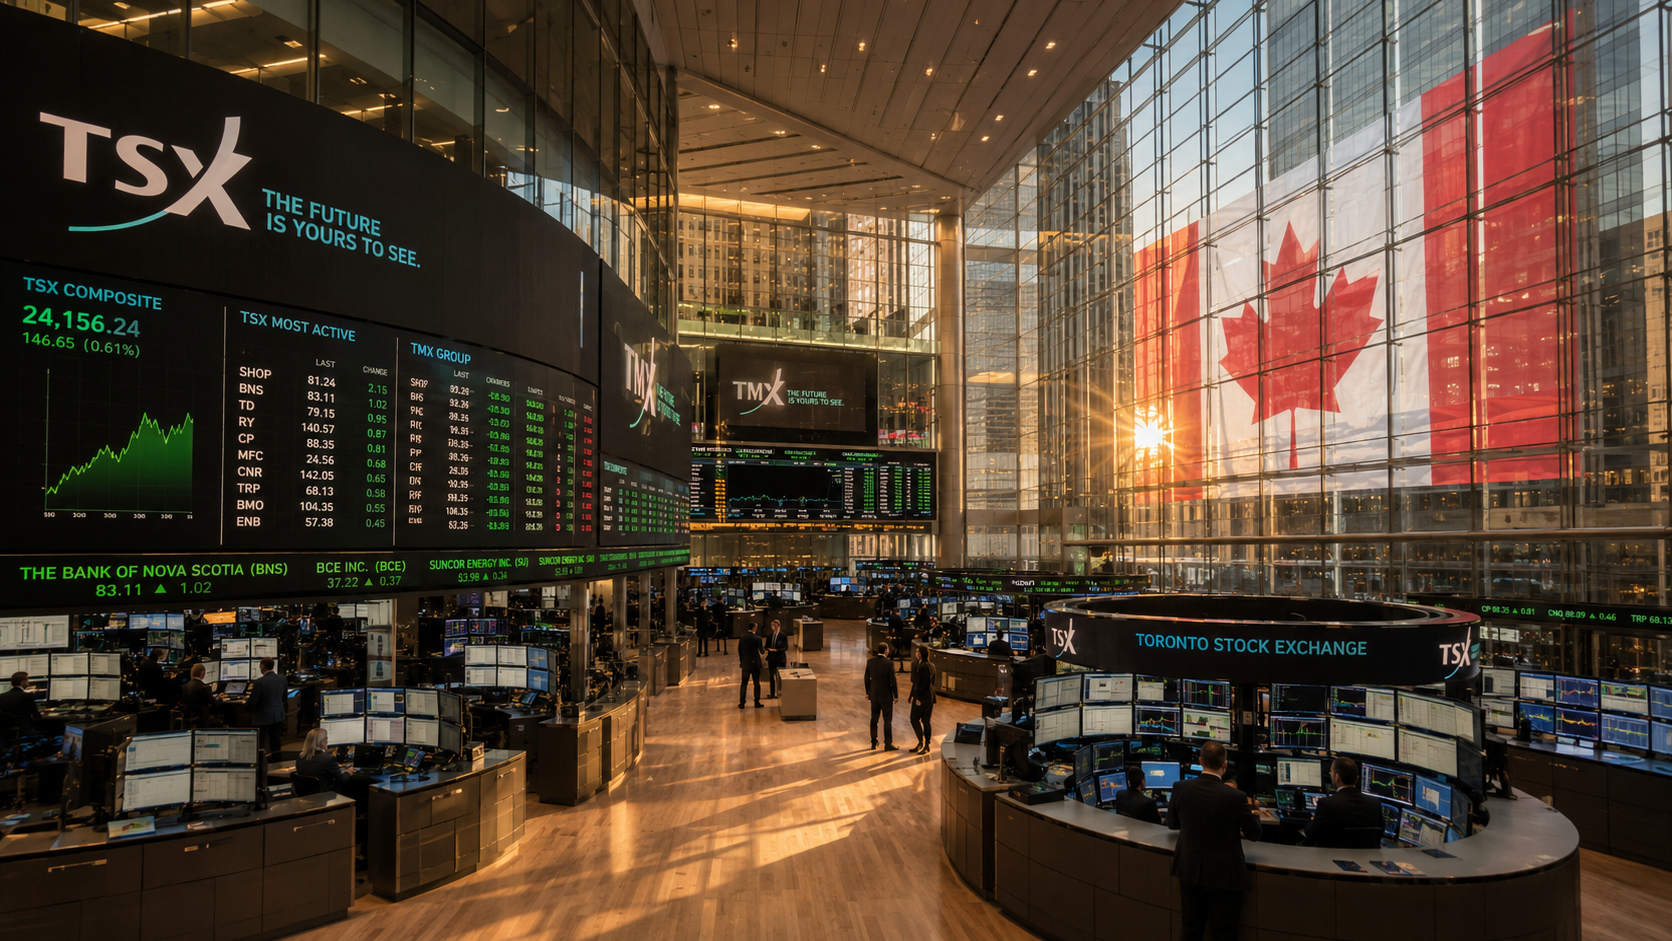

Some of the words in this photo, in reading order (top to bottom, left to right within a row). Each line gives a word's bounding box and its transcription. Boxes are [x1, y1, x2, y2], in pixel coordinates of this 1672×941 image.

[40, 112, 252, 231] TSX
[262, 188, 303, 216] THE
[309, 201, 381, 236] FUTURE
[267, 213, 286, 233] IS
[293, 218, 358, 250] YOURS
[362, 237, 383, 257] TO
[389, 245, 420, 268] SEE.
[23, 277, 58, 294] TSX
[64, 284, 162, 310] COMPOSITE
[23, 305, 141, 338] 24,156.24
[240, 311, 267, 326] TSX
[272, 316, 309, 333] MOST
[312, 324, 355, 341] ACTIVE
[23, 332, 74, 348] 146.65
[84, 339, 139, 358] (0.61%)
[411, 343, 433, 357] TMX
[437, 348, 471, 364] GROUP
[316, 359, 335, 367] LAST
[363, 366, 387, 376] CHANGE
[454, 370, 469, 378] LAST
[623, 336, 657, 418] TMX
[240, 367, 271, 379] SHOP
[308, 376, 335, 387] 81.24
[369, 383, 387, 394] 2.15
[732, 368, 786, 407] TMX
[240, 383, 263, 395] BNS
[308, 391, 334, 403] 83.11
[369, 399, 387, 409] 1.02
[820, 398, 829, 406] TO
[239, 400, 254, 410] TD
[308, 407, 335, 418] 79.15
[368, 414, 387, 424] 0.95
[239, 417, 254, 427] RY
[302, 423, 334, 433] 140.57
[368, 429, 386, 438] 0.87
[238, 433, 254, 443] CP
[307, 439, 334, 449] 88.35
[367, 444, 385, 453] 0.81
[238, 450, 263, 460] MFC
[307, 454, 334, 465] 24.56
[367, 459, 386, 468] 0.68
[238, 466, 262, 477] CNR
[301, 470, 334, 480] 142.05
[367, 474, 385, 483] 0.65
[237, 483, 260, 493] TRP
[306, 486, 333, 496] 68.13
[237, 500, 264, 510] BMO
[300, 502, 333, 511] 104.35
[237, 517, 260, 526] ENB
[306, 518, 333, 527] 57.38
[366, 519, 385, 527] 0.45
[20, 567, 56, 579] THE
[63, 566, 110, 579] BANK
[117, 566, 138, 578] OF
[143, 565, 186, 577] NOVA
[192, 564, 243, 576] SCOTIA
[251, 563, 287, 576] (BNS)
[317, 562, 341, 573] BCE
[346, 562, 368, 572] INC.
[376, 561, 405, 573] (BCE)
[430, 560, 465, 570] SUNCOR
[467, 559, 497, 568] ENERGY
[499, 558, 512, 567] INC.
[96, 584, 140, 596] 83.11
[181, 582, 211, 593] 1.02
[328, 577, 358, 588] 37.22
[380, 576, 401, 586] 0.37
[1480, 604, 1492, 614] CP
[1650, 616, 1672, 624] 68.13
[1051, 617, 1077, 656] TSX
[1136, 633, 1208, 650] TORONTO
[1214, 638, 1269, 653] STOCK
[1276, 640, 1367, 655] EXCHANGE
[1439, 626, 1471, 668] TSX
